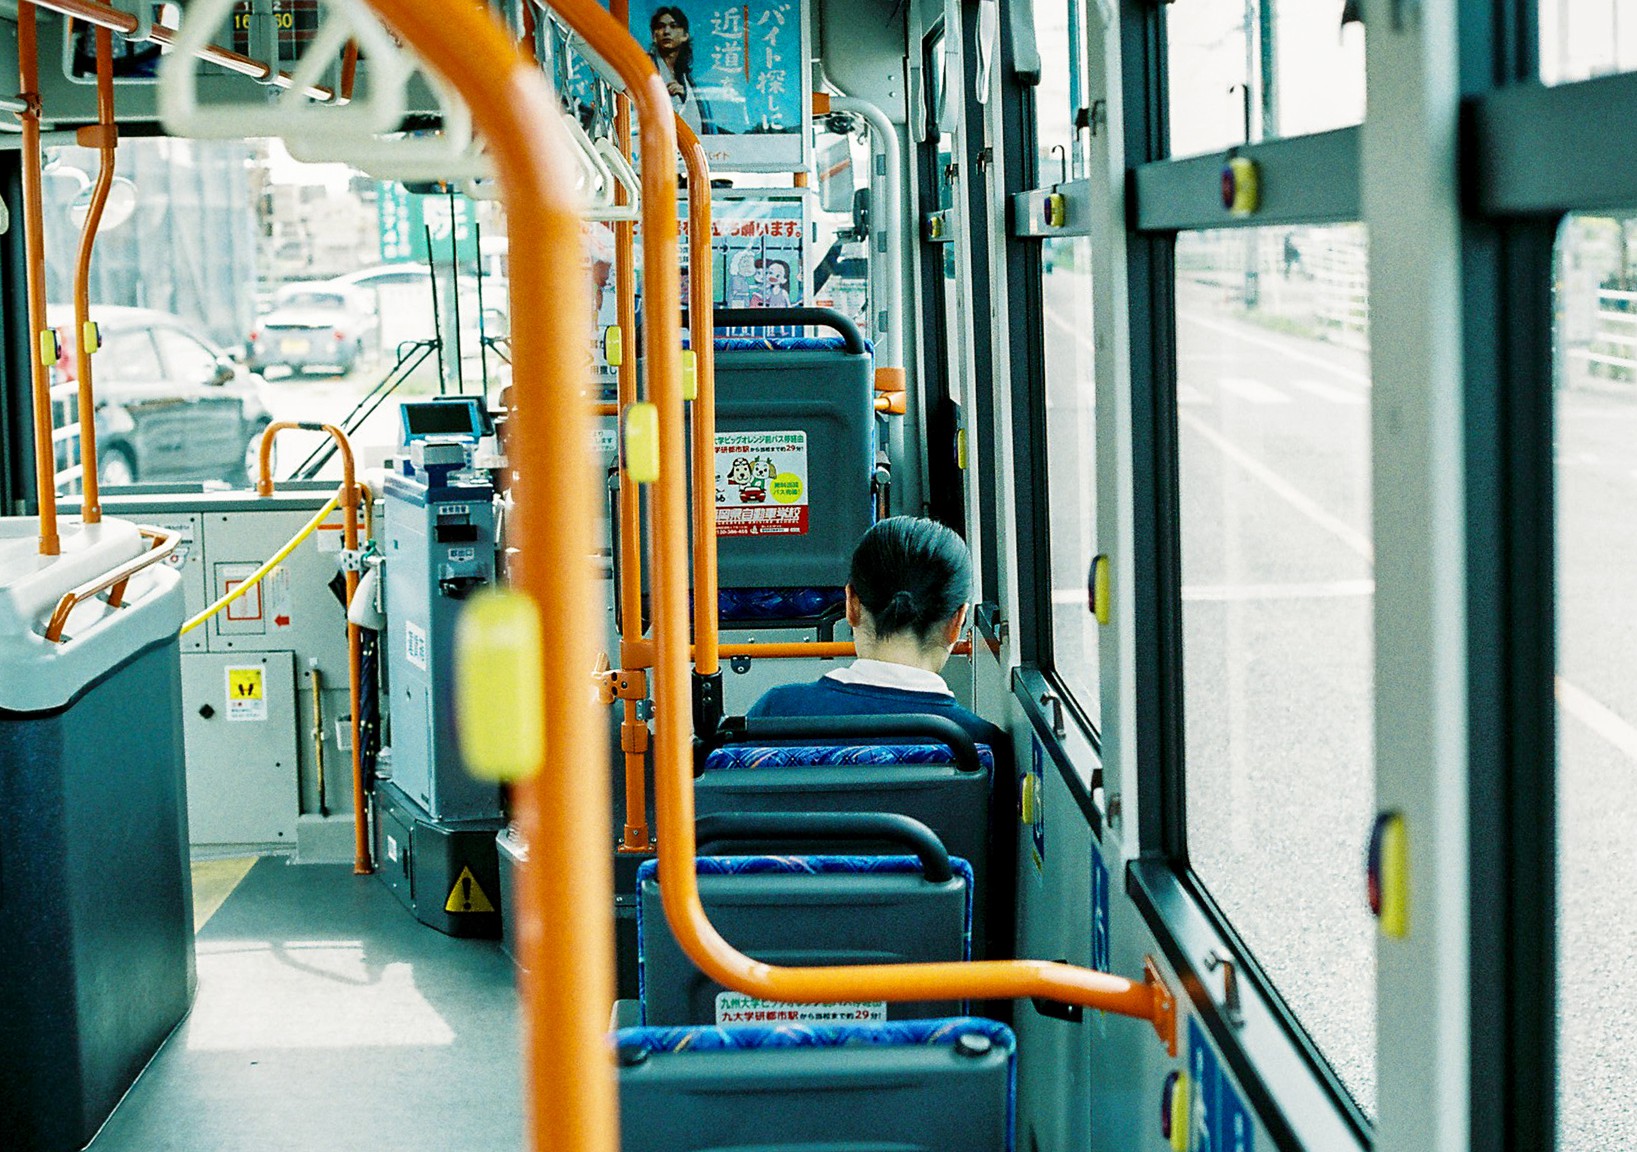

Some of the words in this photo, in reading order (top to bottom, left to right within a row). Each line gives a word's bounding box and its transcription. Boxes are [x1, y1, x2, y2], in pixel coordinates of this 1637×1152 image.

[756, 4, 791, 130] バイト探しに
[715, 435, 804, 445] 学ビッグオレンジ前バス停経由
